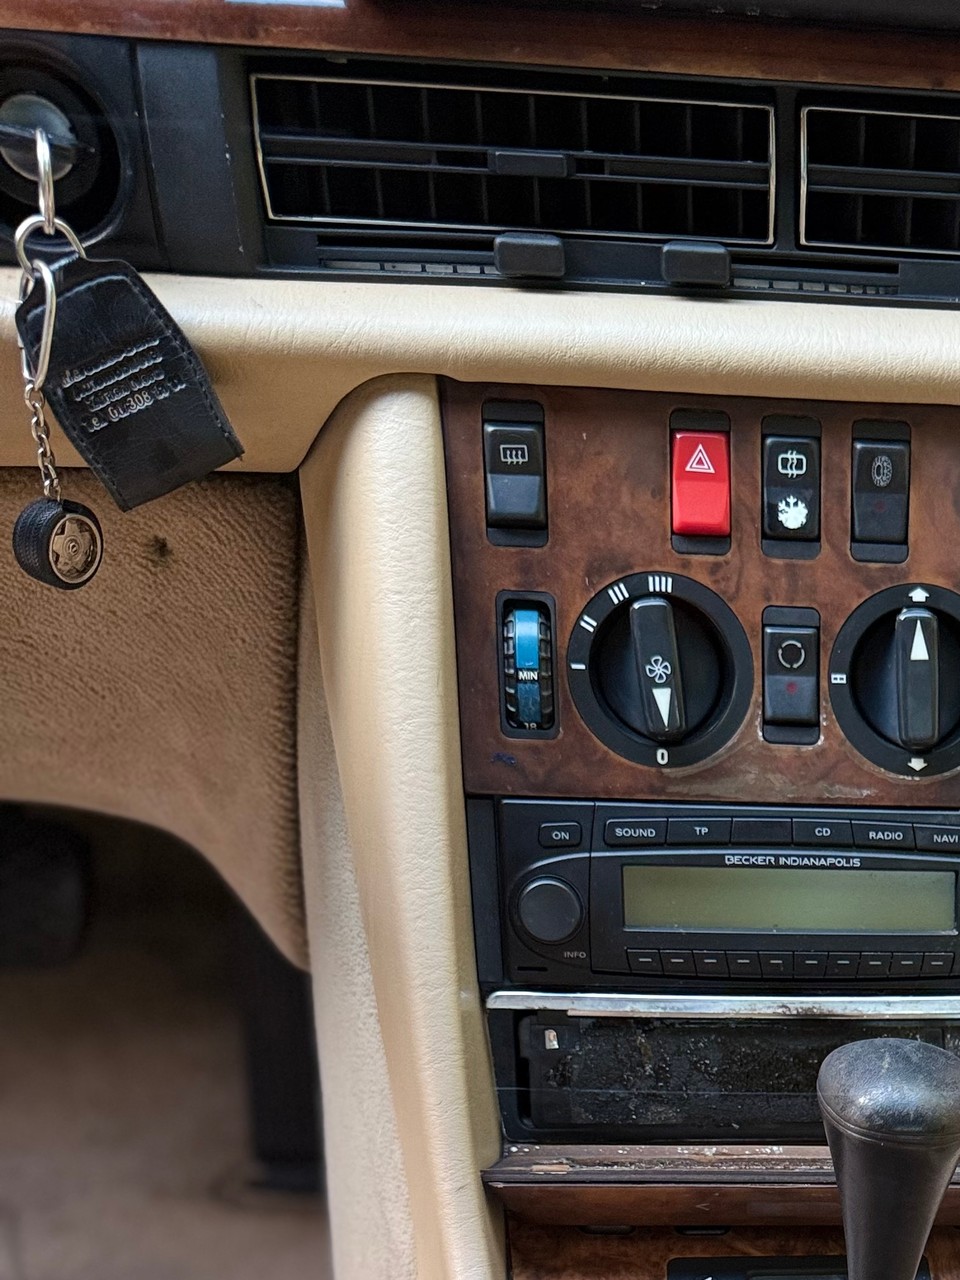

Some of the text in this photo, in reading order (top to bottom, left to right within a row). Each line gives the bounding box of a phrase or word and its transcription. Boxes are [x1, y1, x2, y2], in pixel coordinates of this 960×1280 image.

[518, 670, 538, 681] MIN
[552, 831, 570, 841] ON
[615, 827, 656, 838] SOUND
[694, 826, 709, 836] TP
[815, 827, 831, 837] CD
[868, 830, 903, 842] RADIO
[933, 833, 959, 844] NAVI
[725, 855, 861, 867] BECKER INDIANAPOLIS
[564, 951, 587, 959] INFO
